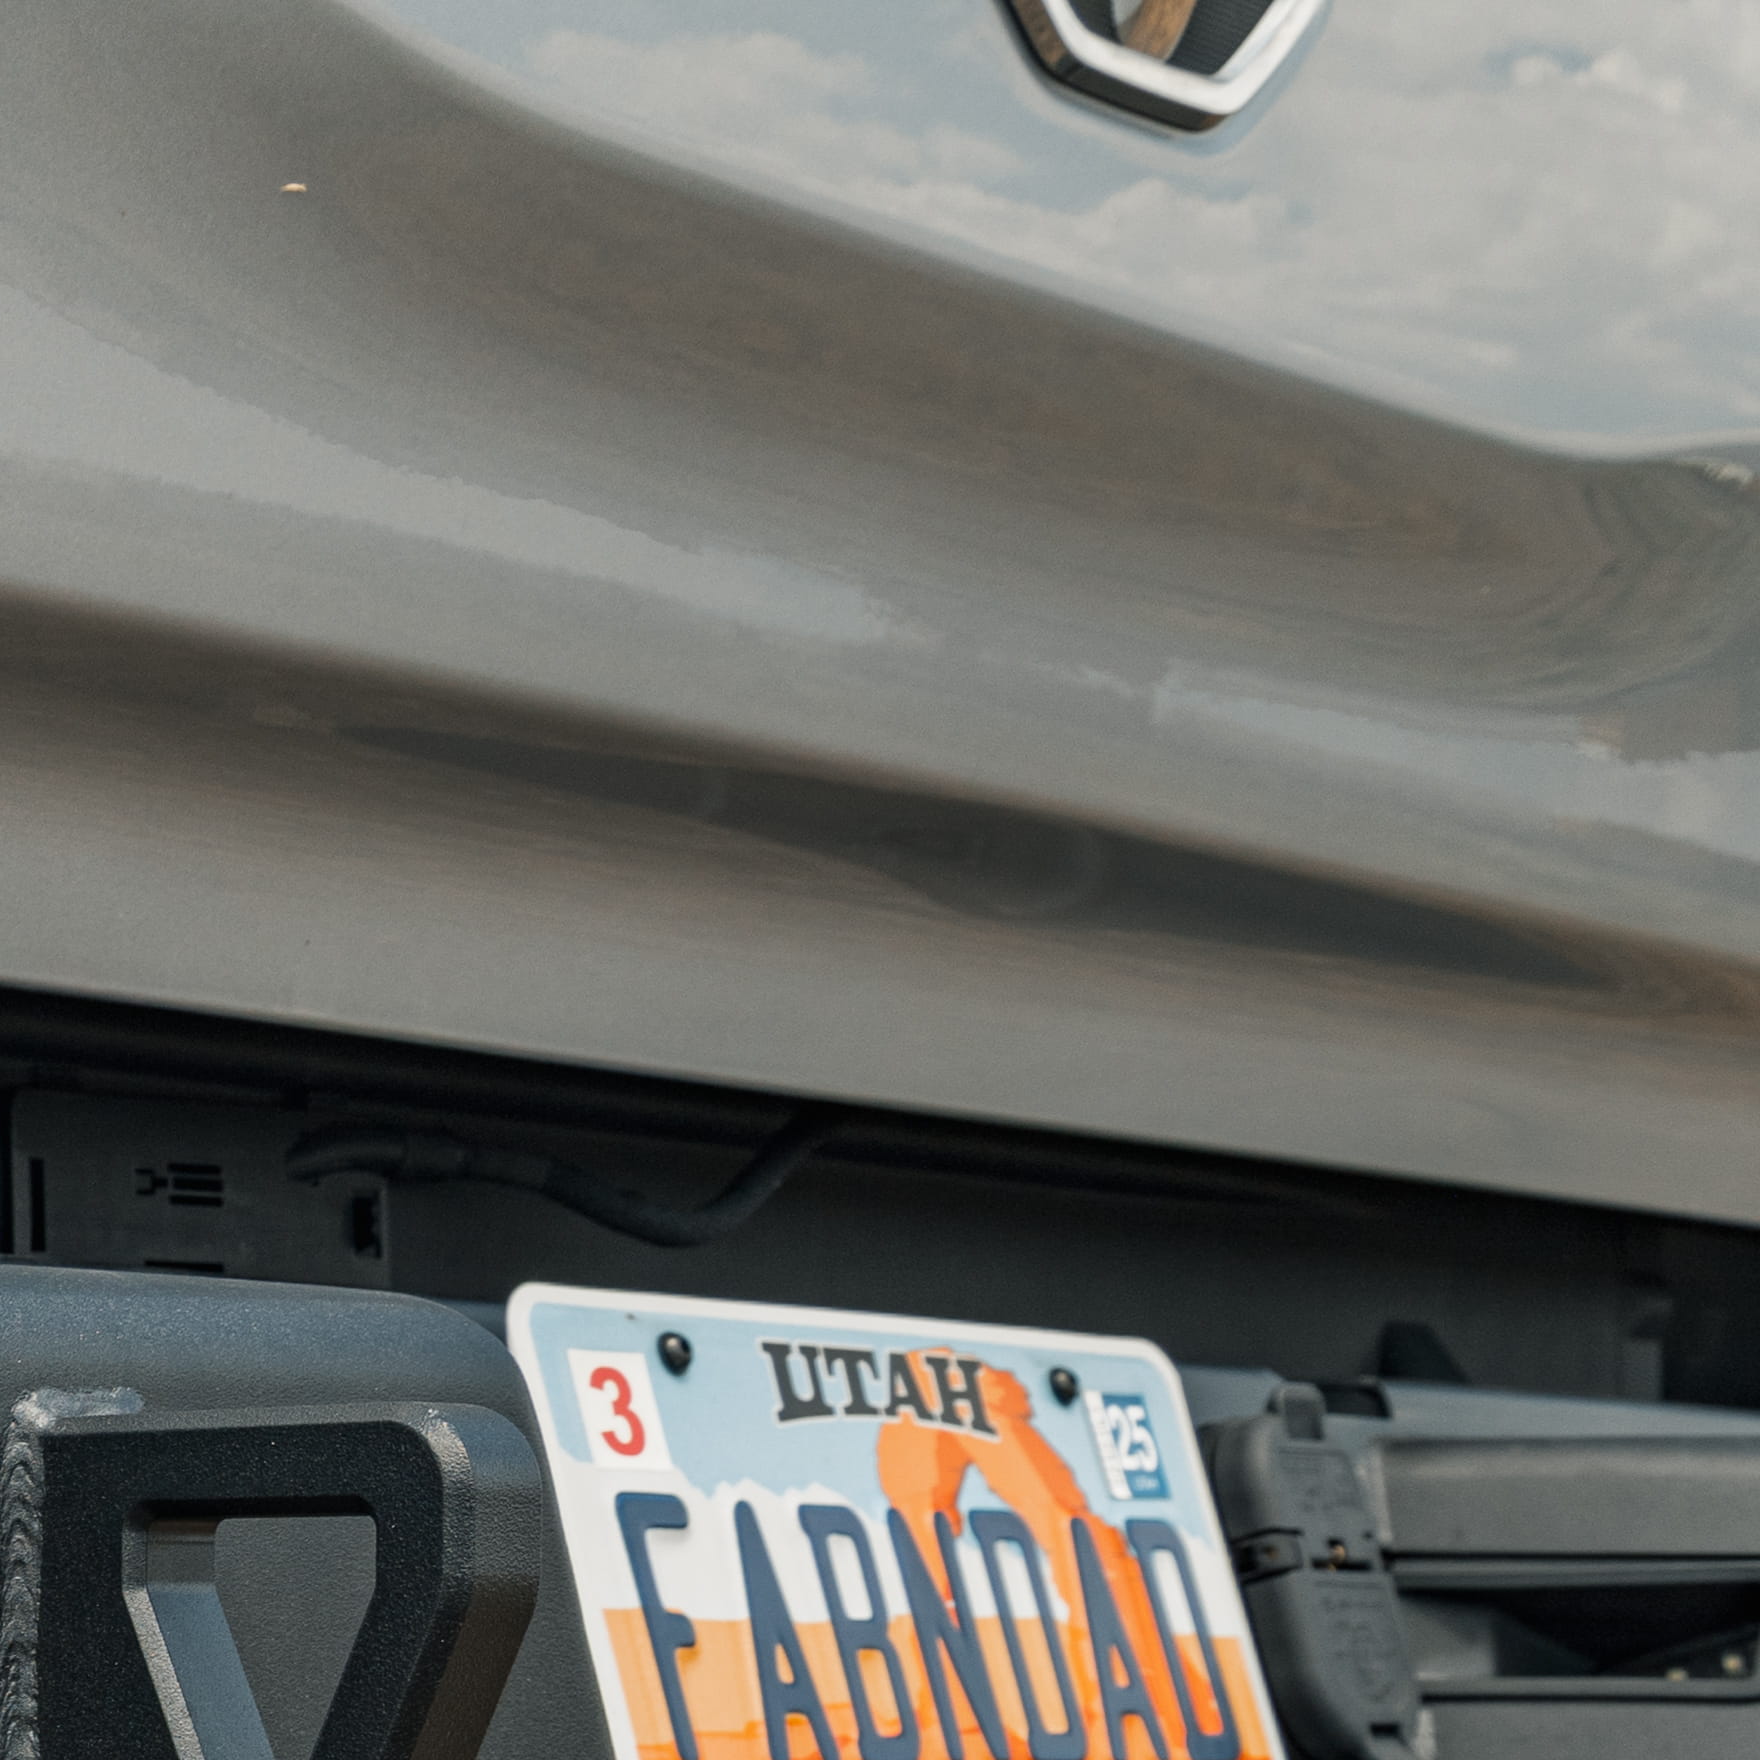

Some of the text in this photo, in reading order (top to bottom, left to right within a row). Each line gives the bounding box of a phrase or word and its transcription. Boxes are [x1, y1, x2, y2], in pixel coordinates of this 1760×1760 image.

[588, 1366, 646, 1457] 3
[762, 1341, 1000, 1438] UTAH
[1105, 1403, 1159, 1473] 25
